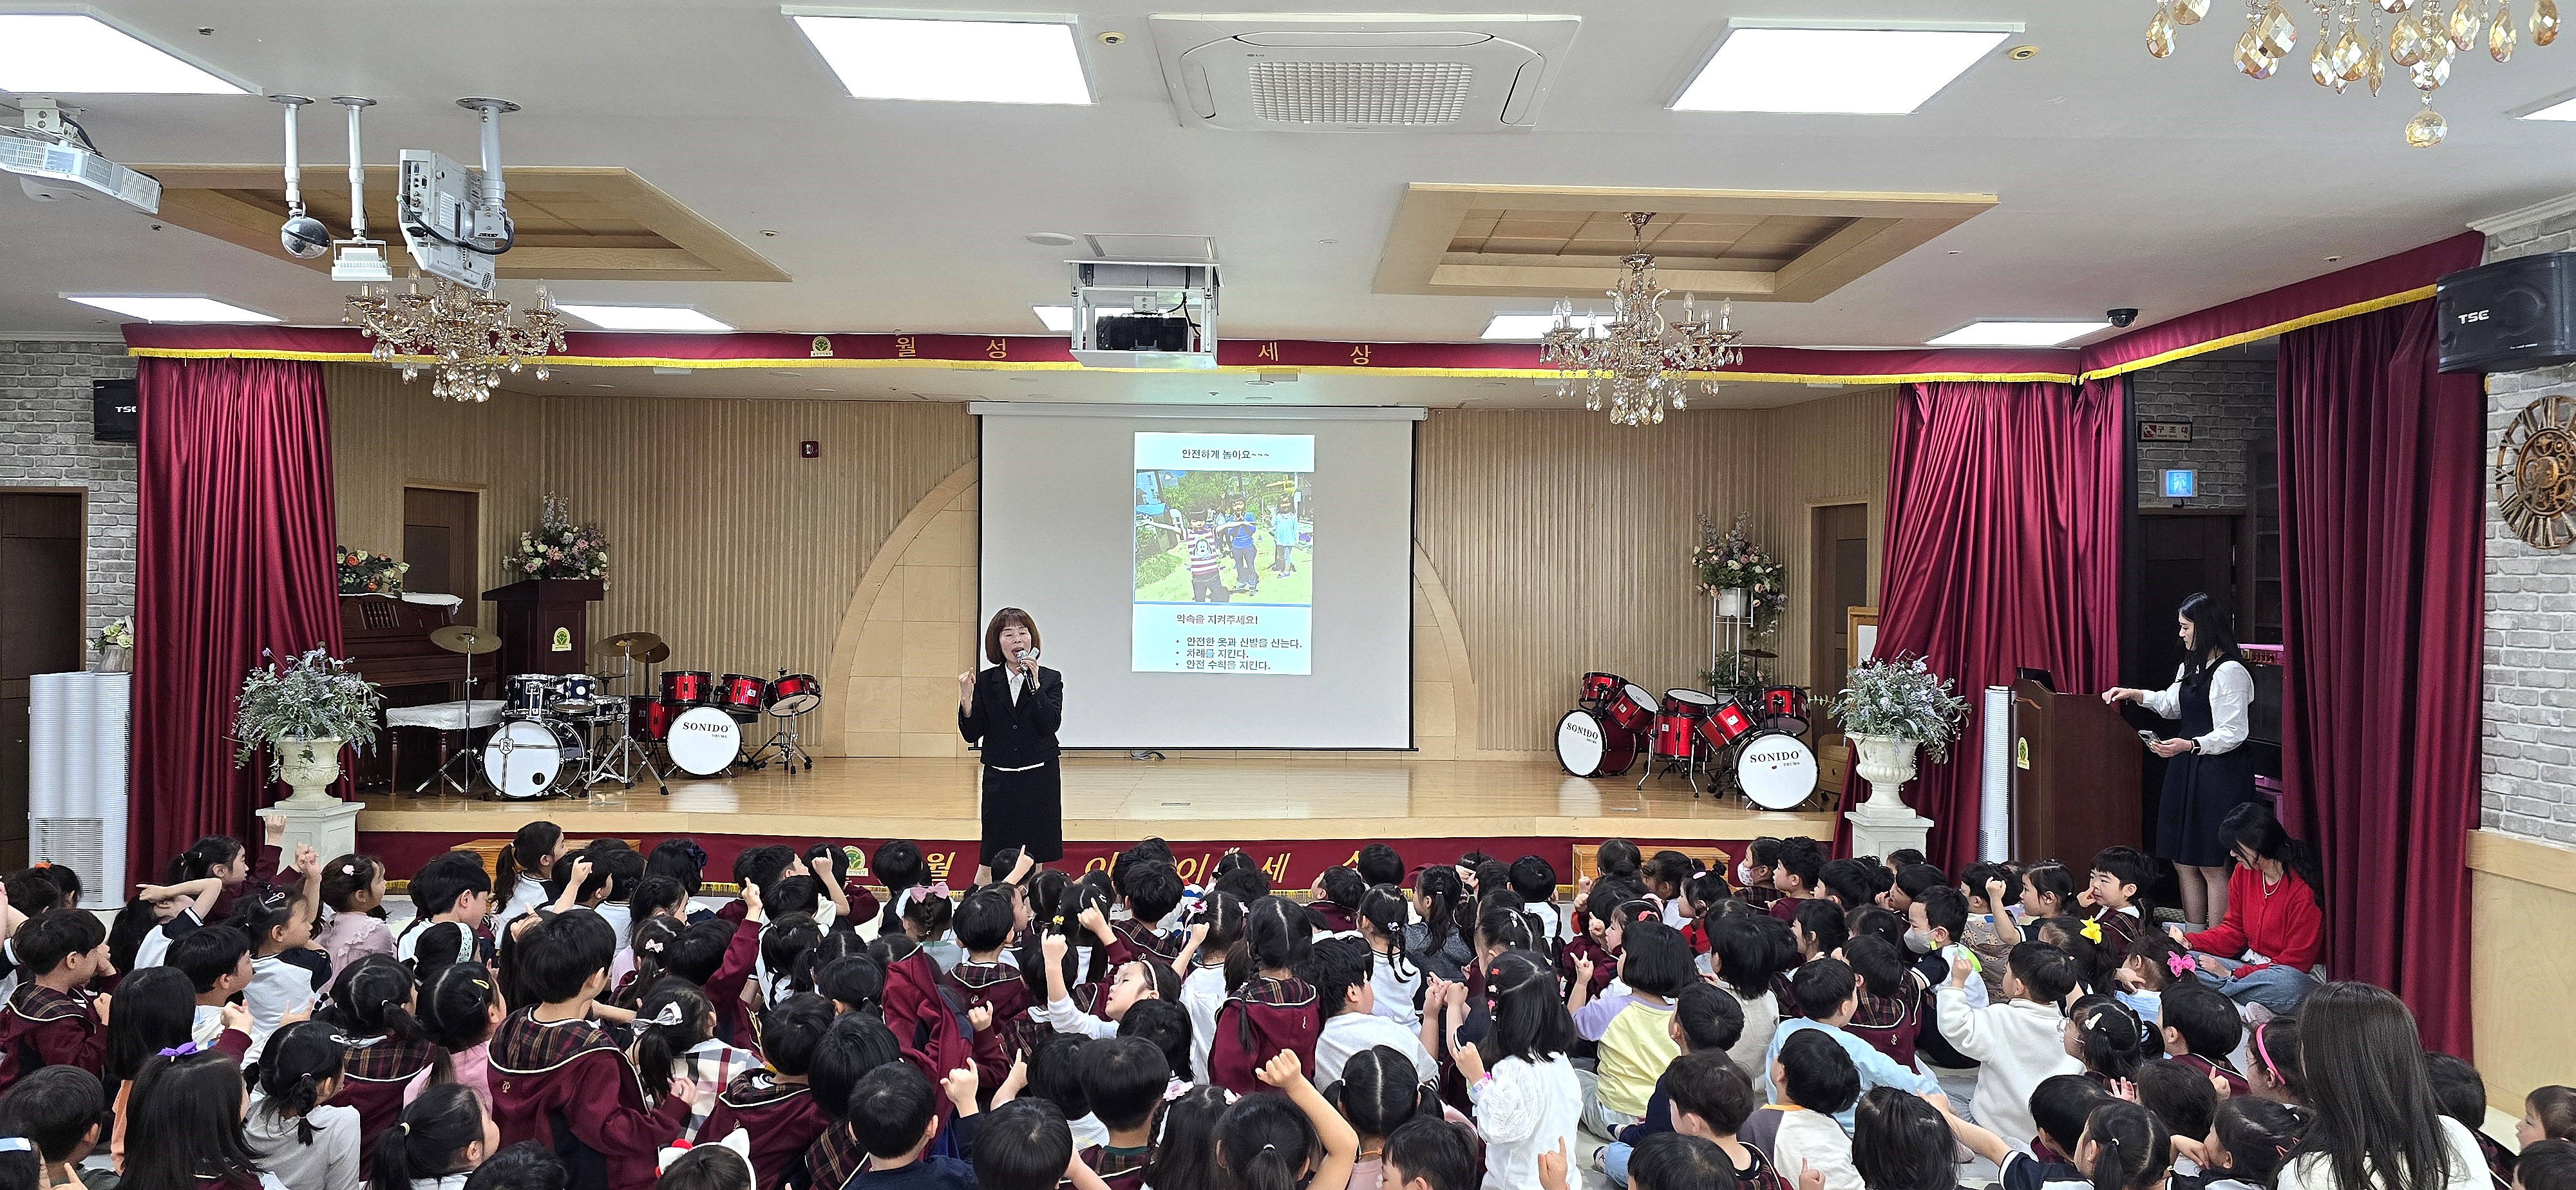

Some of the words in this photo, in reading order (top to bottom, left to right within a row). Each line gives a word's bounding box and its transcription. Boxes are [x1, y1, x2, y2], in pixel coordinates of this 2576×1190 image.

[2458, 309, 2490, 325] TSE
[895, 336, 916, 357] 월
[985, 338, 1007, 359] 성
[1258, 341, 1278, 361] 세
[1350, 345, 1372, 365] 상
[1182, 449, 1220, 459] 안전하게
[1222, 449, 1269, 460] 놀아요~~~
[1177, 614, 1205, 625] 약속을
[1208, 614, 1258, 625] 지켜주세요!
[1186, 637, 1215, 647] 안전한
[1217, 638, 1236, 648] 옷과
[1240, 638, 1268, 648] 신발을
[1271, 638, 1302, 649] 신는다.
[1186, 648, 1215, 659] 차례를
[1217, 648, 1249, 659] 지킨다.
[1186, 659, 1206, 669] 안전
[1208, 660, 1236, 670] 수칙을
[1239, 660, 1271, 671] 지킨다.
[683, 722, 728, 733] SONIDO
[1566, 722, 1598, 740] SONIDO
[1750, 751, 1799, 763] SONIDO
[927, 851, 956, 882] 월
[1261, 853, 1291, 883] 세
